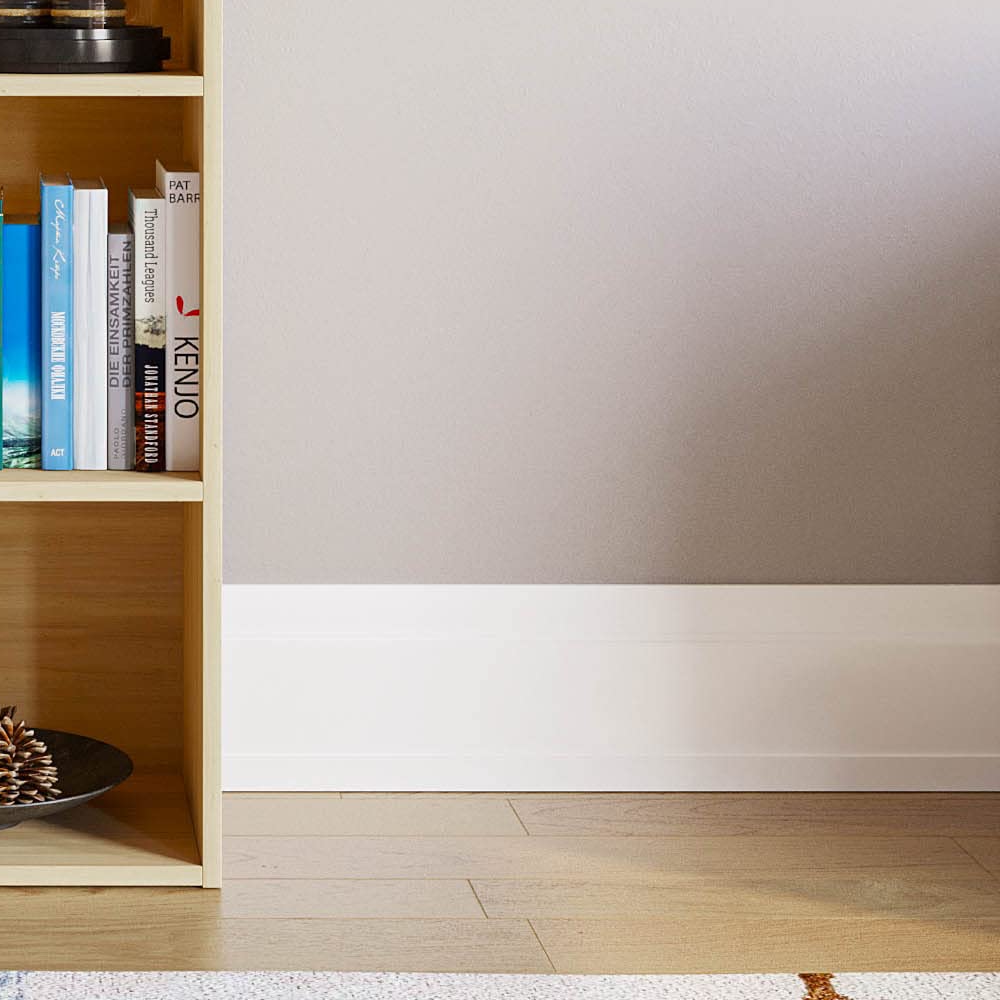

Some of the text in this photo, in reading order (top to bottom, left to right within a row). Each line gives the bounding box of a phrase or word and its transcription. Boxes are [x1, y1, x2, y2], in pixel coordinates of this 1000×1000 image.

[169, 180, 191, 190] PAT
[142, 208, 158, 303] Thousand Leagues
[109, 254, 120, 388] DIE EINSAMKEIT
[122, 241, 132, 388] DER PRIMZAHLEN
[144, 364, 158, 464] JONATHAN STANDFORD
[174, 337, 199, 418] KENJO
